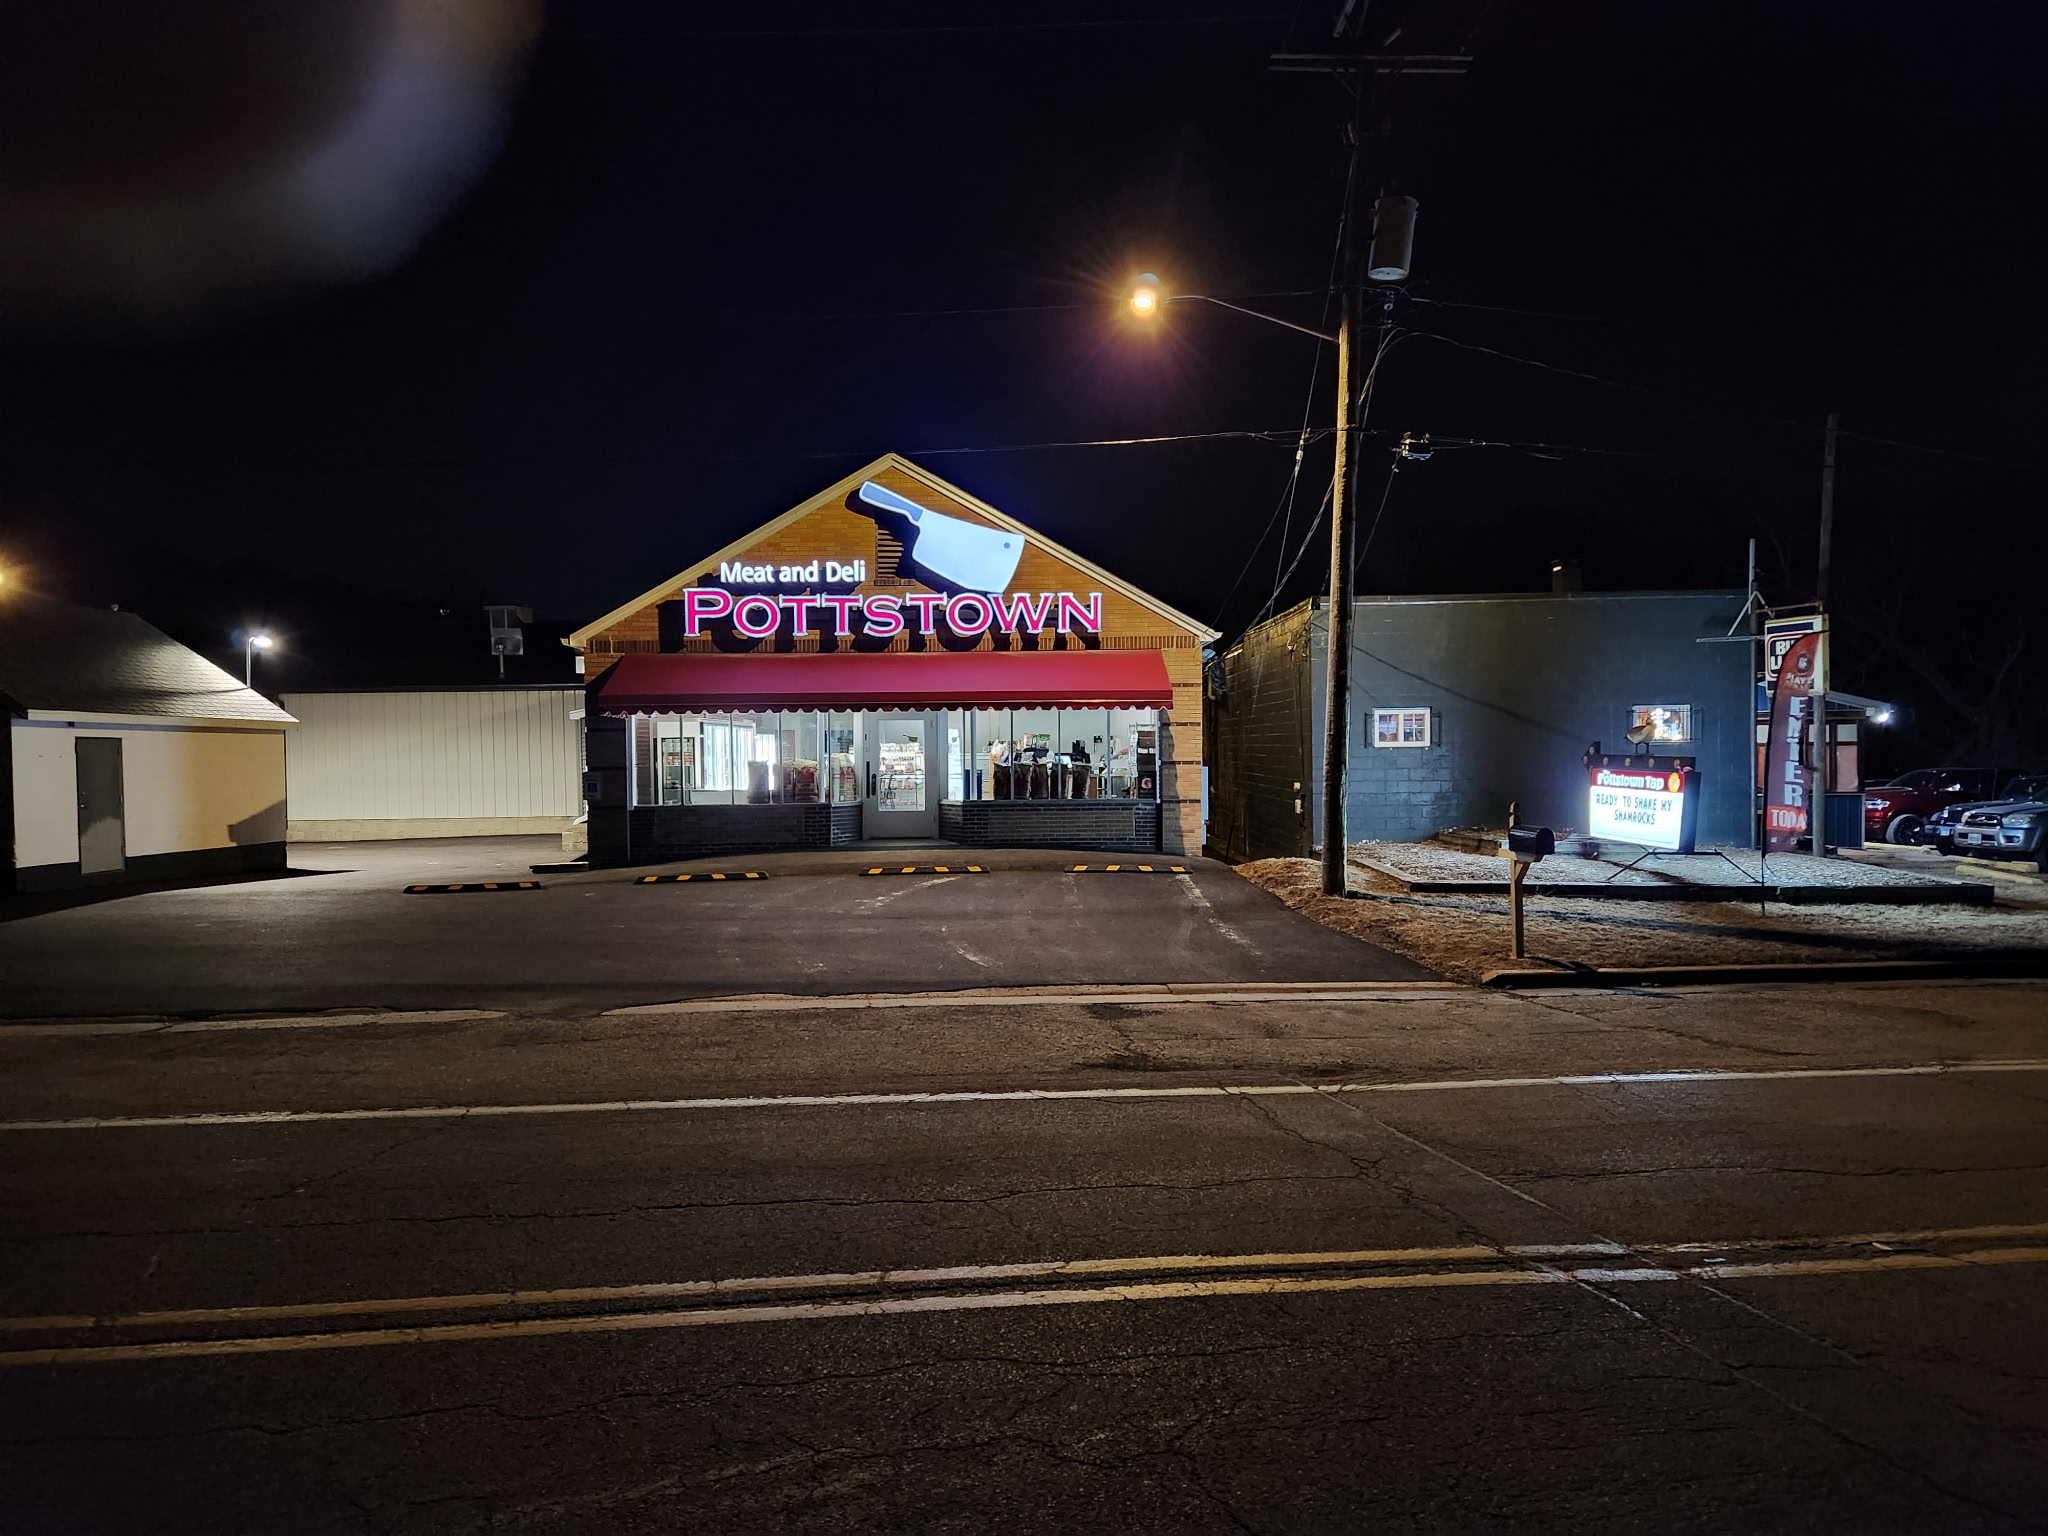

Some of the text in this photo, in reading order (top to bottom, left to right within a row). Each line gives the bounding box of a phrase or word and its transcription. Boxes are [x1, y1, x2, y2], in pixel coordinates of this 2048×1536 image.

[720, 559, 866, 584] Meat and Deli
[683, 587, 1103, 638] POTTSTOWN
[1597, 772, 1665, 790] Pottstown Tap
[1596, 793, 1673, 812] READY TO SHAKE MY
[1614, 809, 1656, 825] SHAMROCKS
[1770, 809, 1808, 830] TODA
